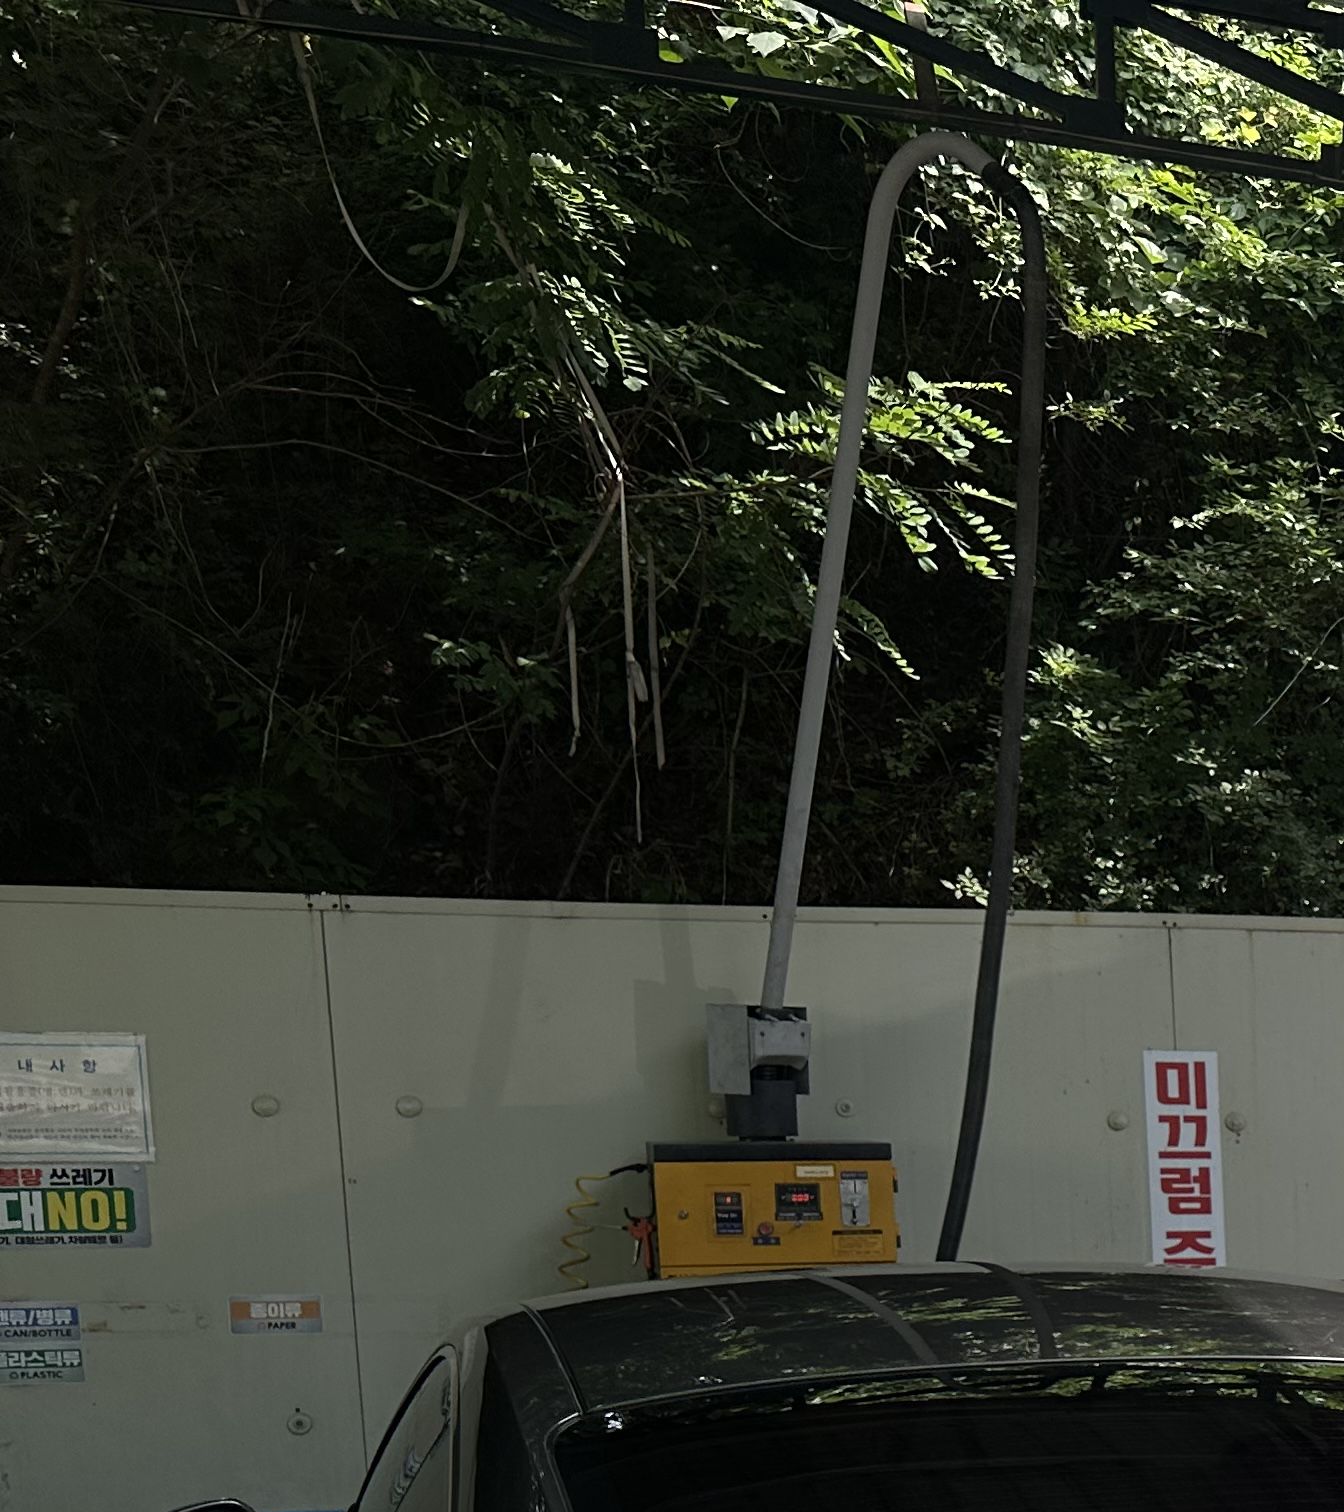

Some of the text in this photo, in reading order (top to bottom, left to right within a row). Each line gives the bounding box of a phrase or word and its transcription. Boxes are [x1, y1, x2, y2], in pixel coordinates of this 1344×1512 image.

[1154, 1060, 1213, 1215] 미끄럼
[49, 1168, 115, 1187] 쓰레기
[267, 1321, 297, 1330] PAPER
[4, 1329, 73, 1338] CAN/BOTTLE
[20, 1371, 63, 1379] PLASTIC
